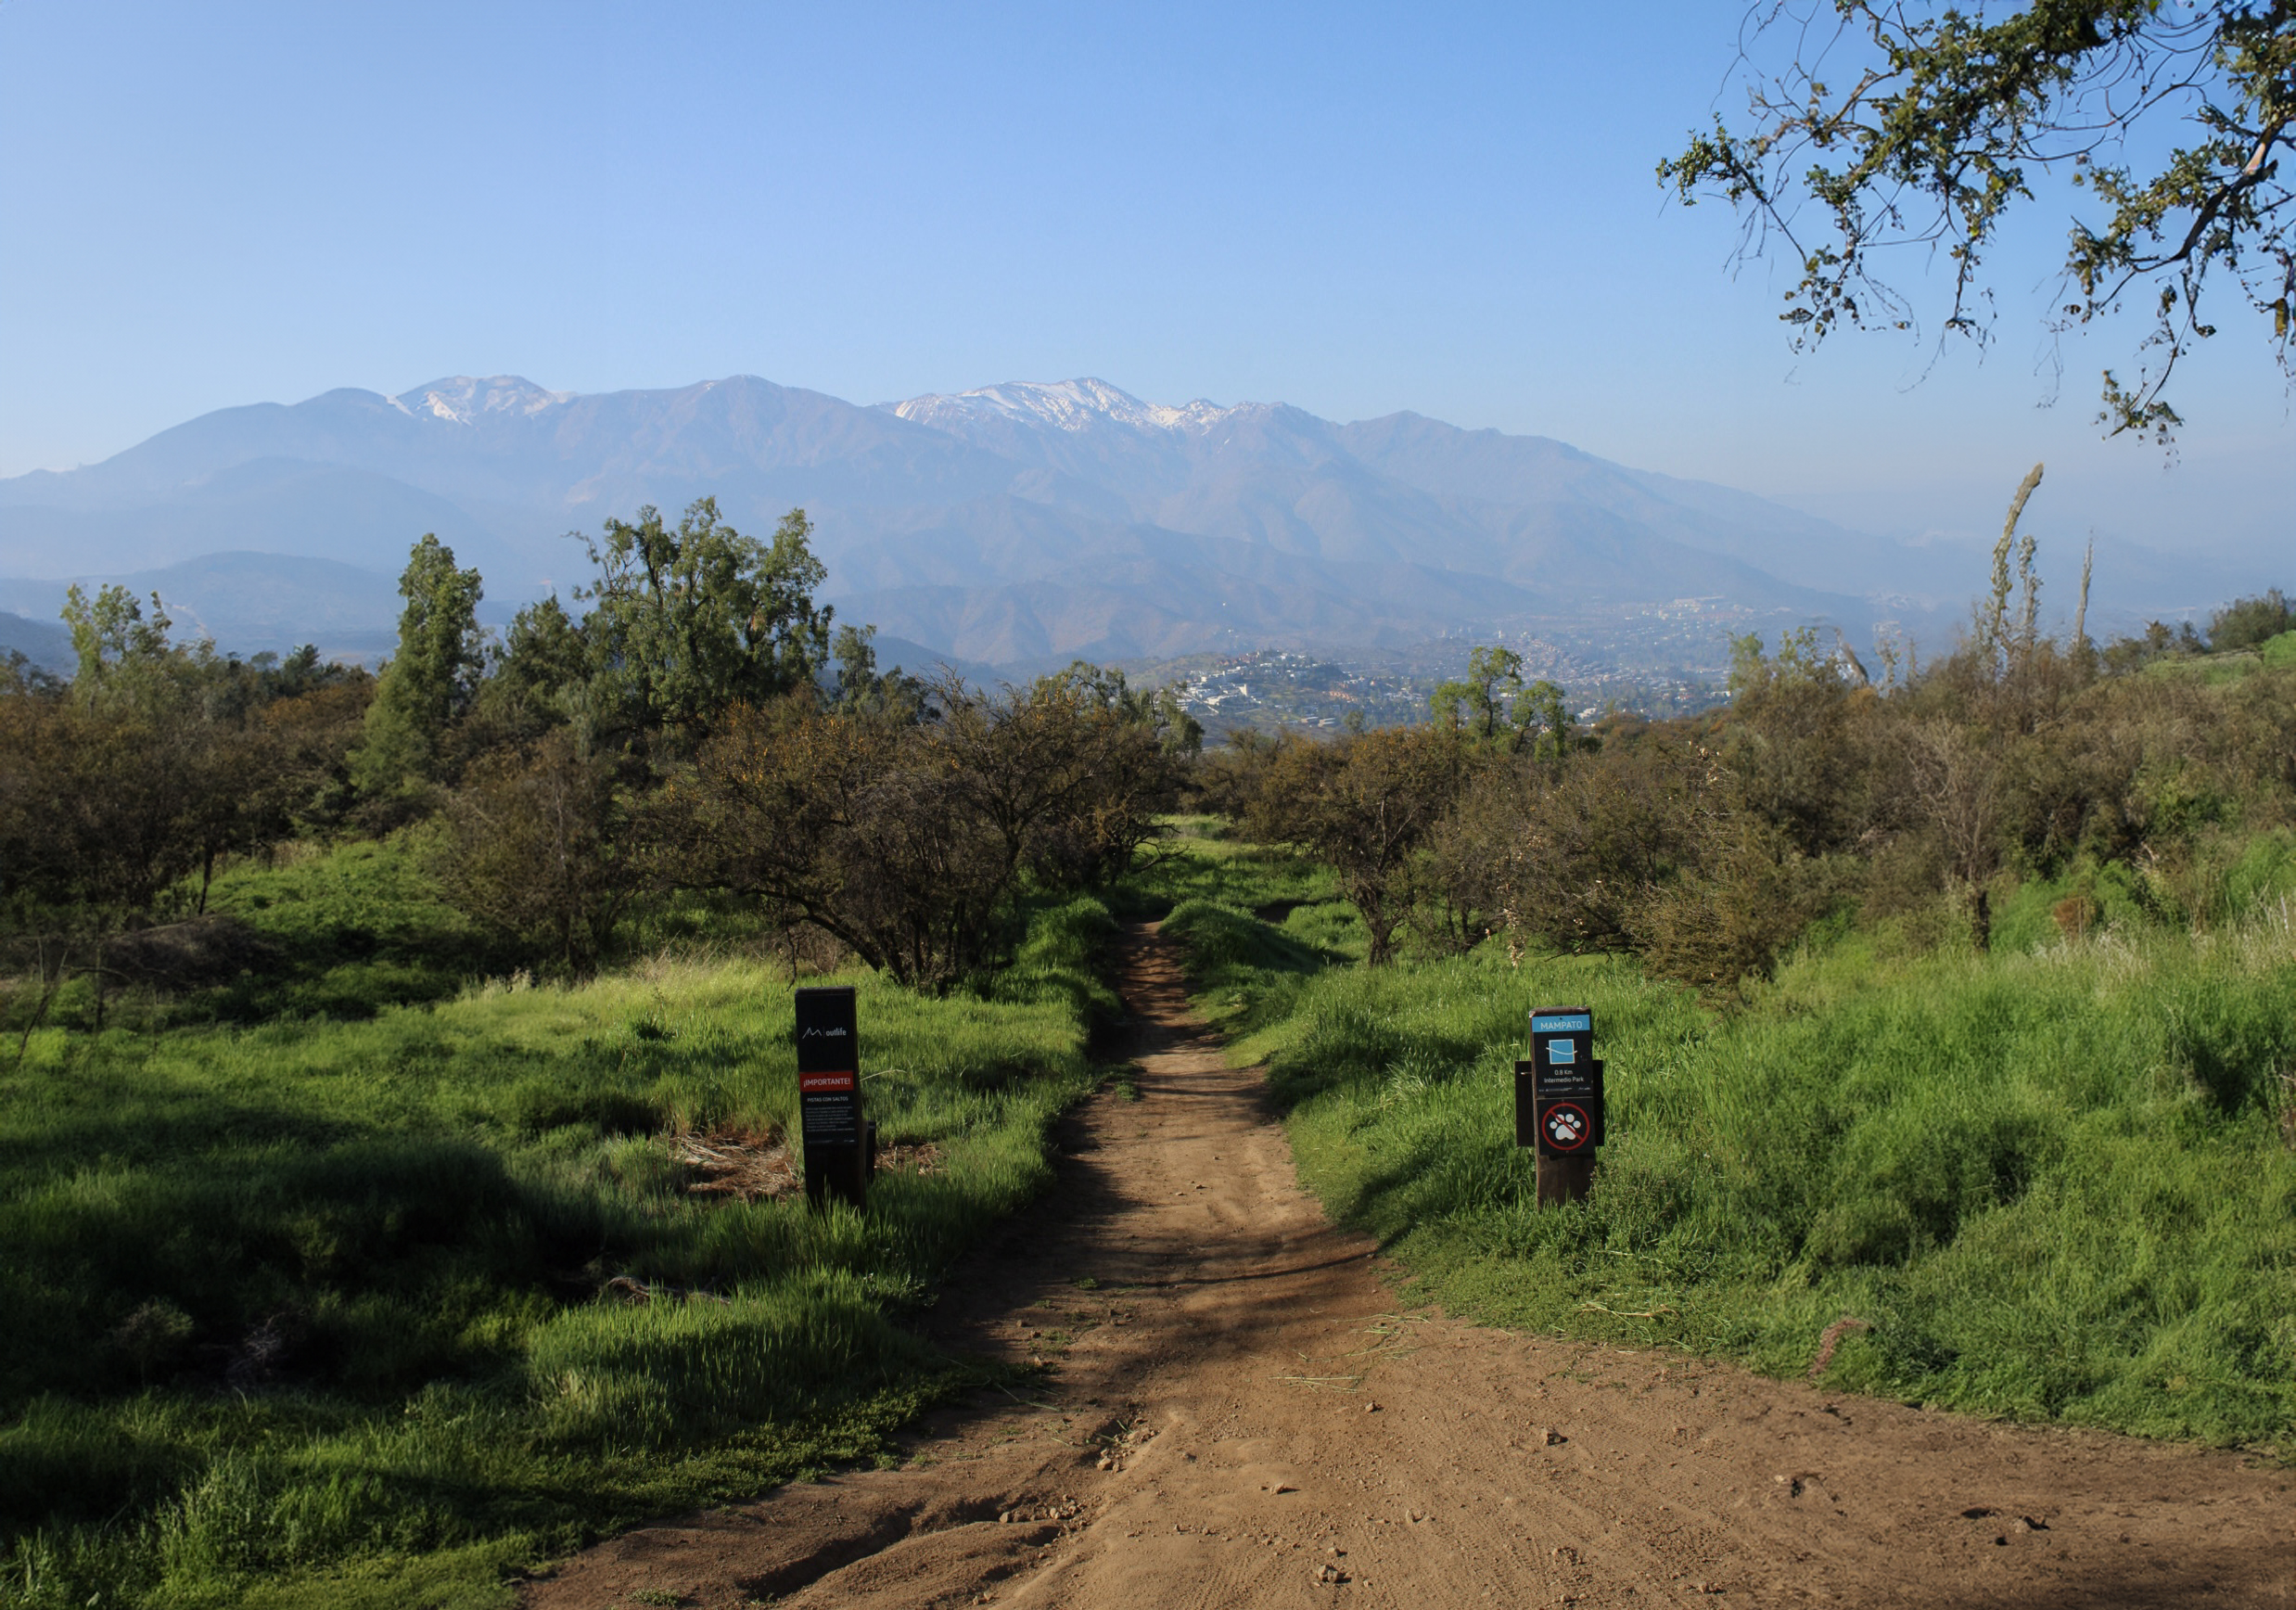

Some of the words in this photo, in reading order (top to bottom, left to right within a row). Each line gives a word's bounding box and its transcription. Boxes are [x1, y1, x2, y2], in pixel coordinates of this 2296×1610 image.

[1540, 1021, 1583, 1030] MAMPATO
[825, 1028, 847, 1036] outlife
[803, 1078, 850, 1088] ¡IMPORTANTE!
